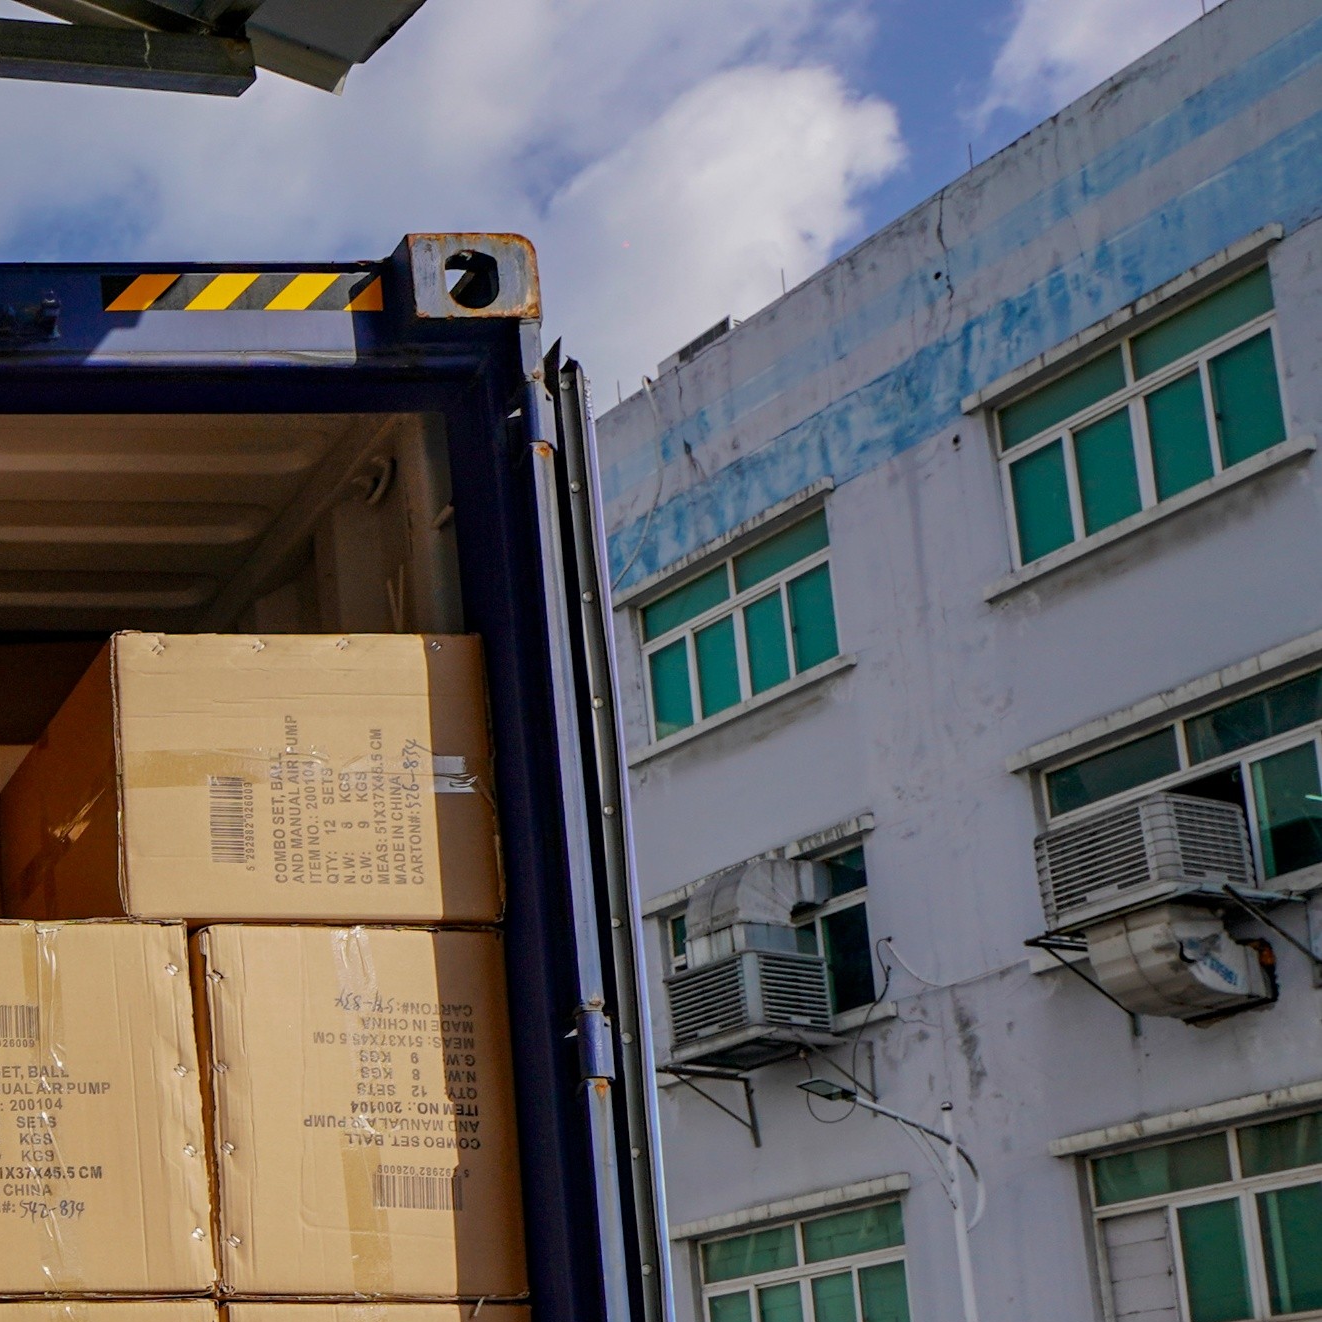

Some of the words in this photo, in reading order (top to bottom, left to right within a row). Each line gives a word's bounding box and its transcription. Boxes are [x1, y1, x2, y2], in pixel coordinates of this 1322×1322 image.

[269, 751, 283, 789] BALL
[303, 760, 319, 811] 200104
[272, 827, 288, 883] COMBO
[407, 809, 425, 884] CARTON#:
[308, 848, 322, 883] ITEM
[3, 1183, 53, 1196] CHINA
[79, 1166, 103, 1178] CM
[19, 1200, 85, 1224] 542-834
